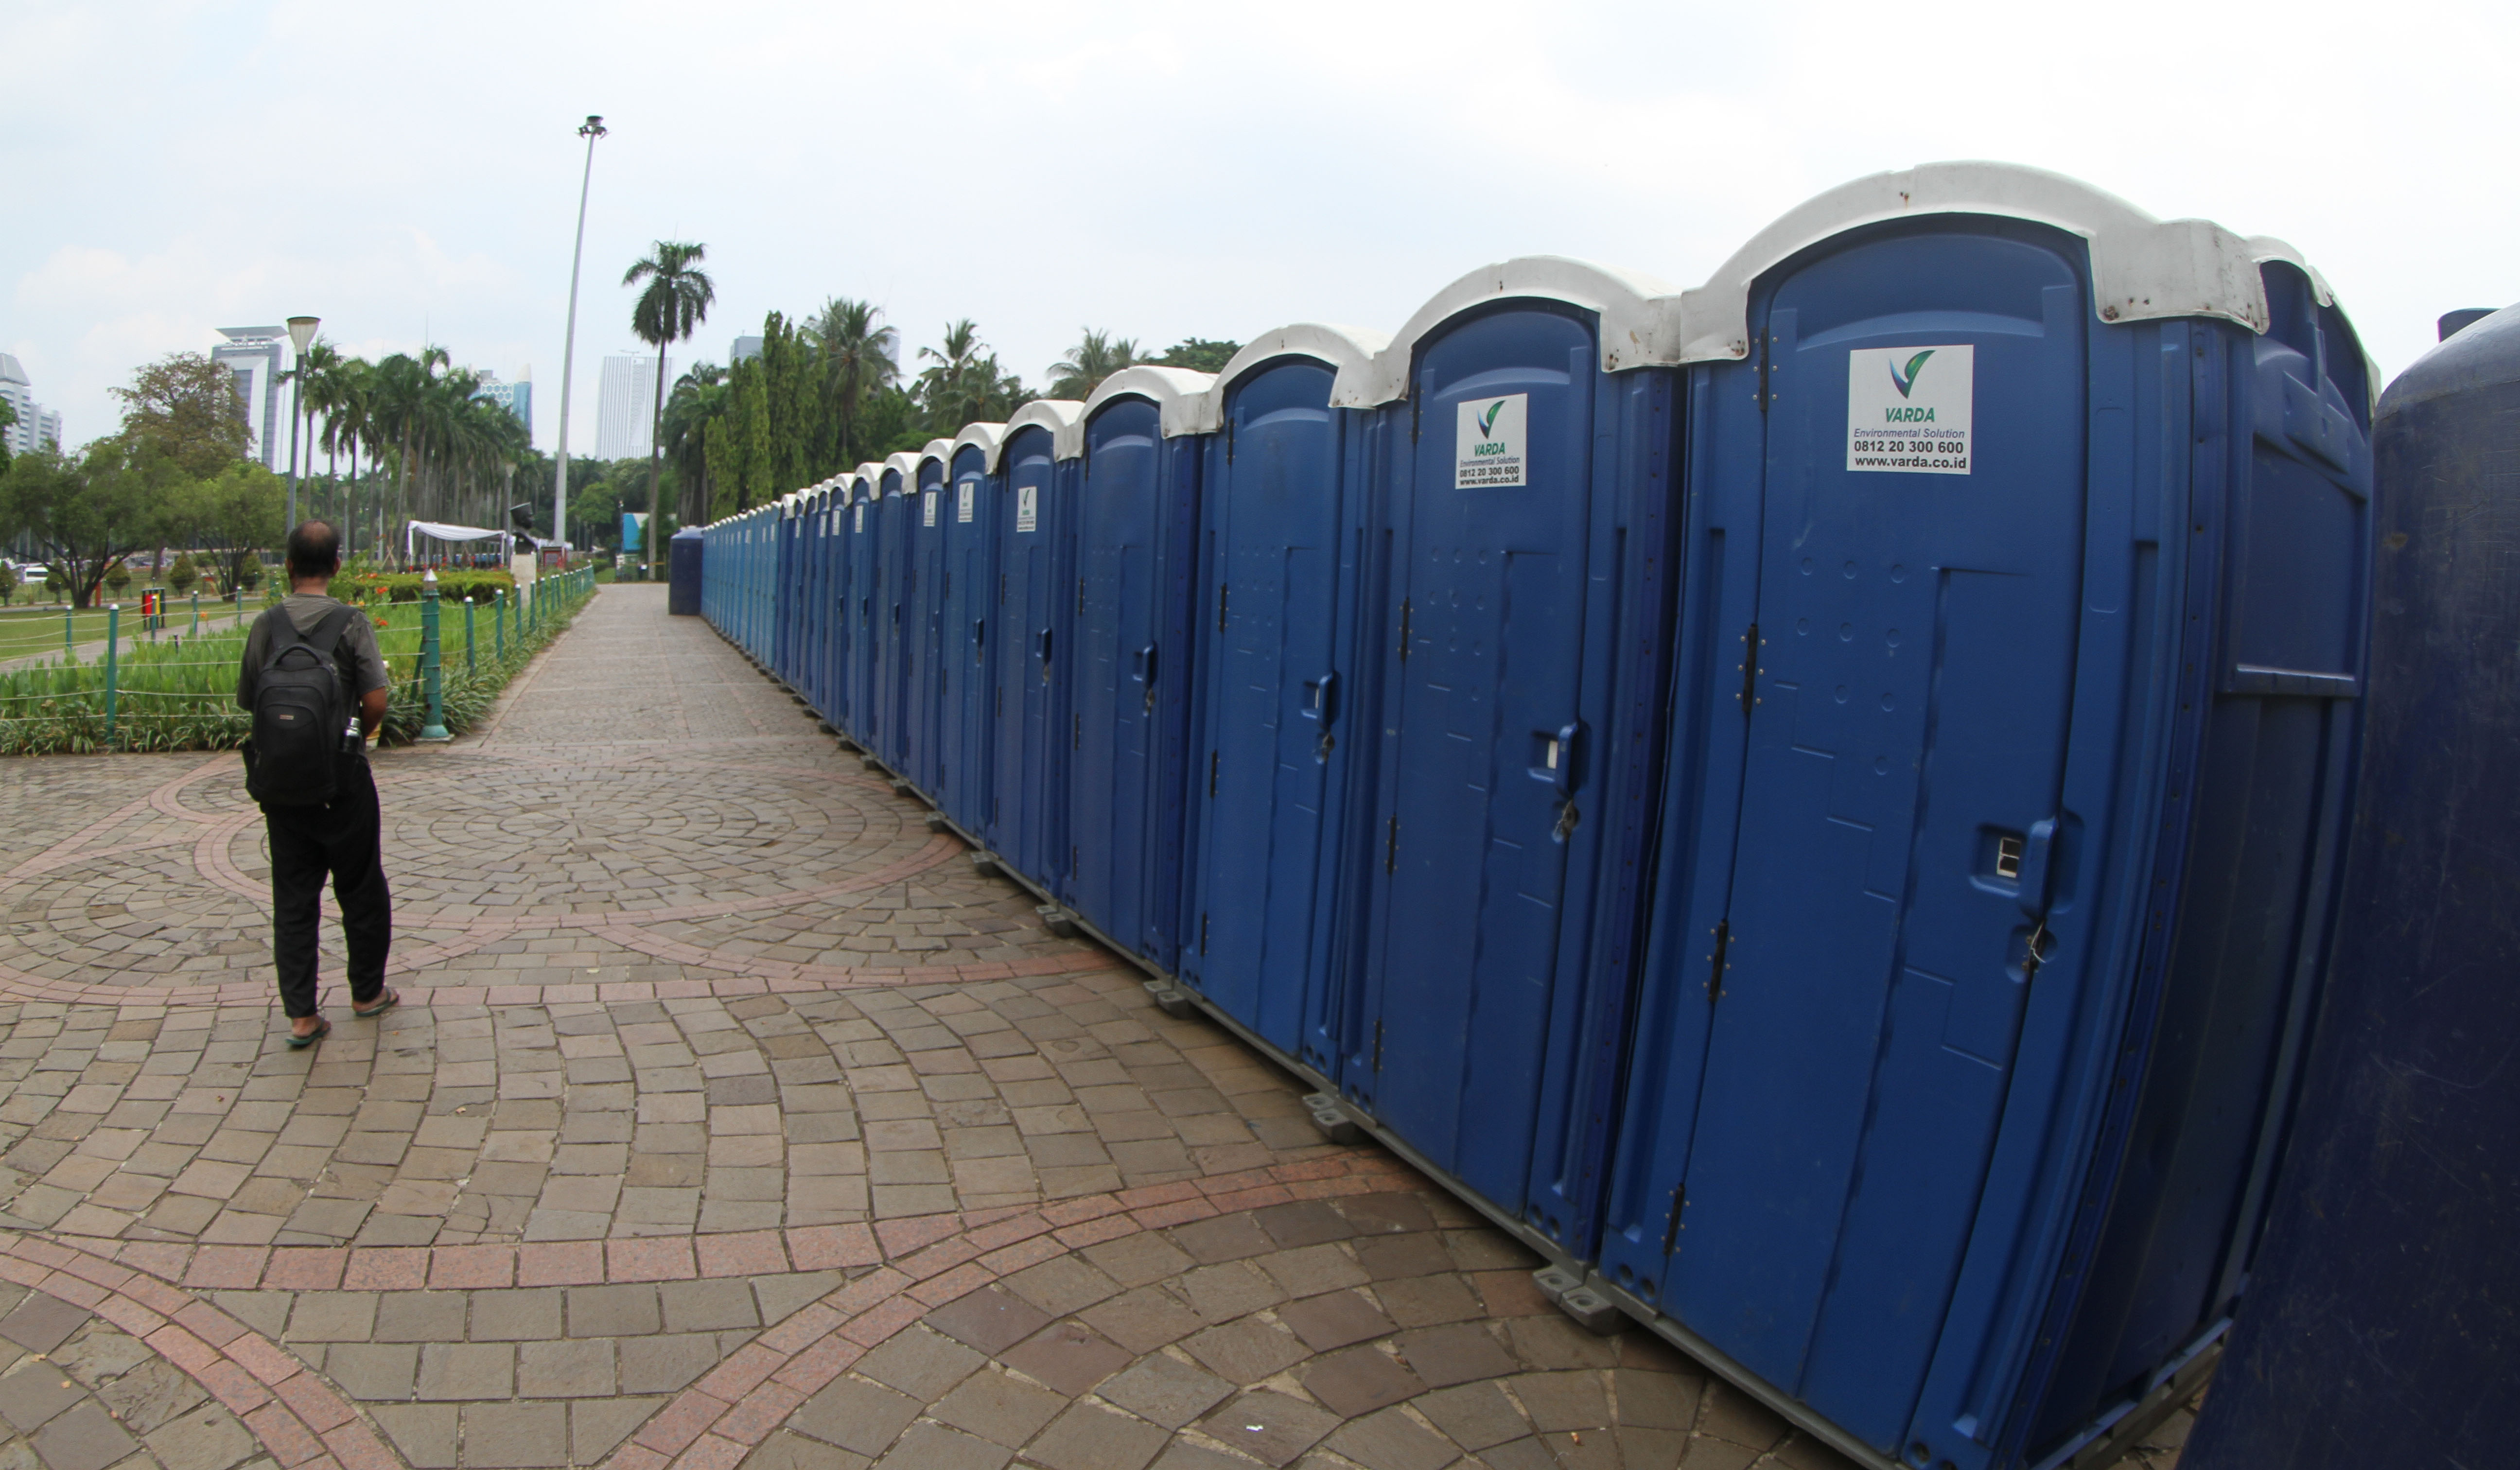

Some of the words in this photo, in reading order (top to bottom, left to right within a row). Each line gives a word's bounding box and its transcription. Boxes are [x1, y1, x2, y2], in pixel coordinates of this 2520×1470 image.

[1886, 407, 1935, 422] VARDA
[1854, 428, 1920, 438] Environmental
[1923, 428, 1964, 438] Solution
[1474, 442, 1505, 456] VARDA
[1854, 441, 1885, 452] 0812
[1889, 441, 1904, 452] 20
[1909, 441, 1933, 453] 300
[1938, 441, 1963, 454] 600
[1497, 456, 1520, 464] Solution
[1855, 456, 1966, 469] www.varda.co.id
[1460, 469, 1475, 477] 0812
[1505, 466, 1519, 474] 600
[1460, 475, 1519, 485] www.varda.co.id
